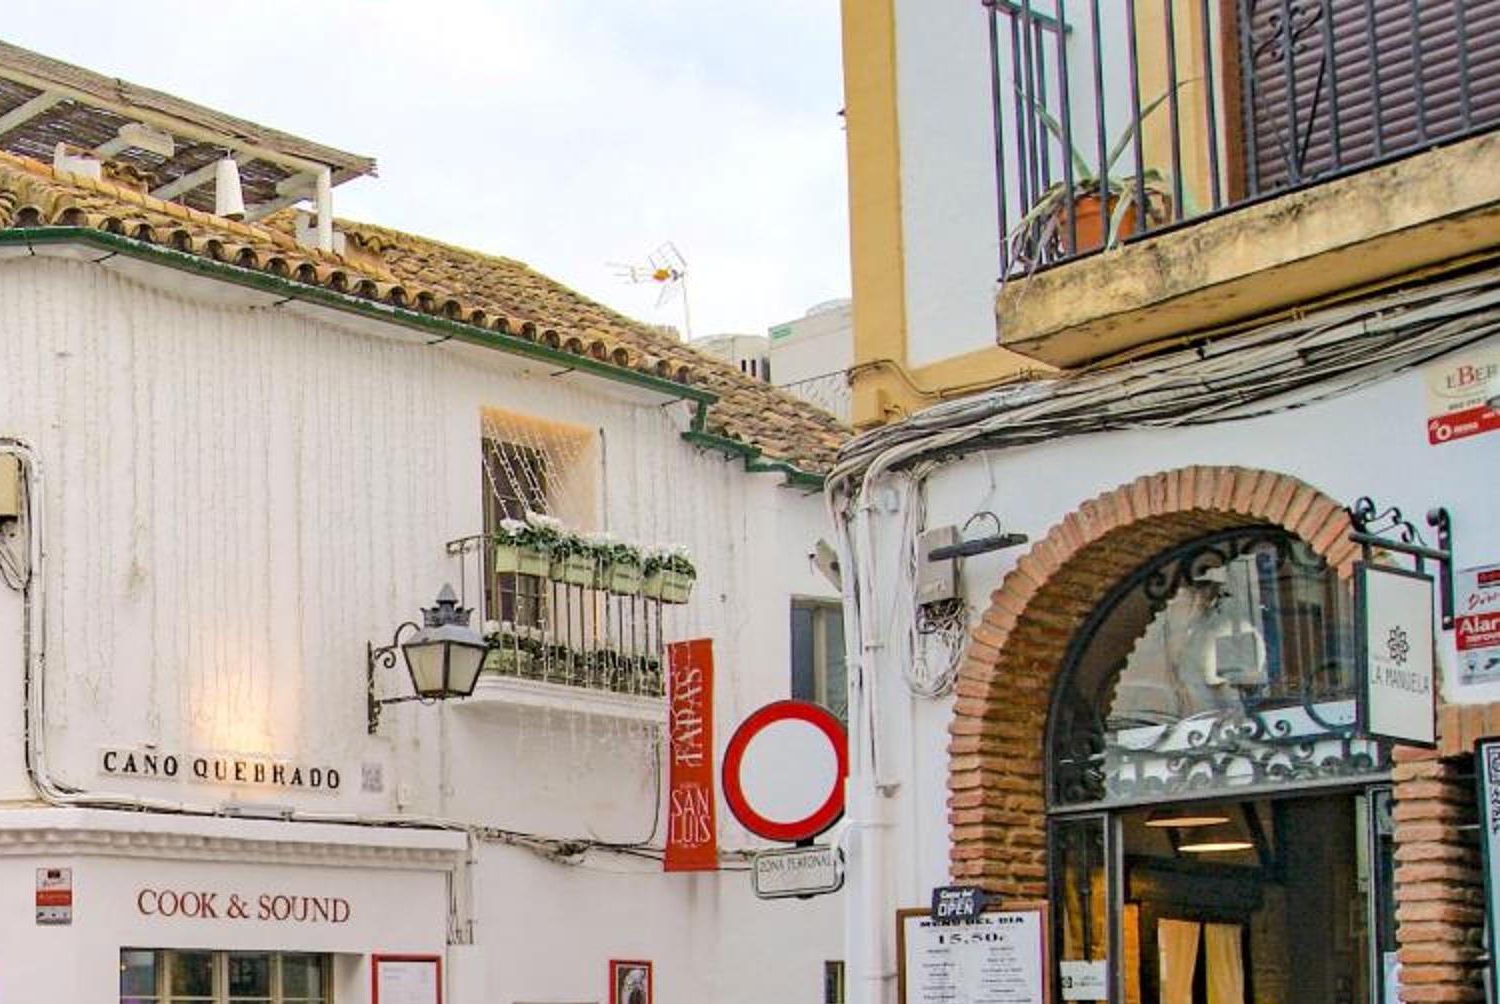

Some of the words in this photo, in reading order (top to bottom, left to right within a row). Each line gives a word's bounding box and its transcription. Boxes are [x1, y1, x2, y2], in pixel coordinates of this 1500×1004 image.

[1385, 668, 1431, 695] MANUELA
[102, 743, 179, 777] CAÑO
[193, 758, 341, 790] QUEBRADO
[671, 787, 710, 817] SAN
[671, 815, 712, 844] LUIS
[137, 888, 219, 919] COOK
[226, 893, 250, 920] &
[257, 894, 351, 924] SOUND
[937, 902, 975, 917] OPEN
